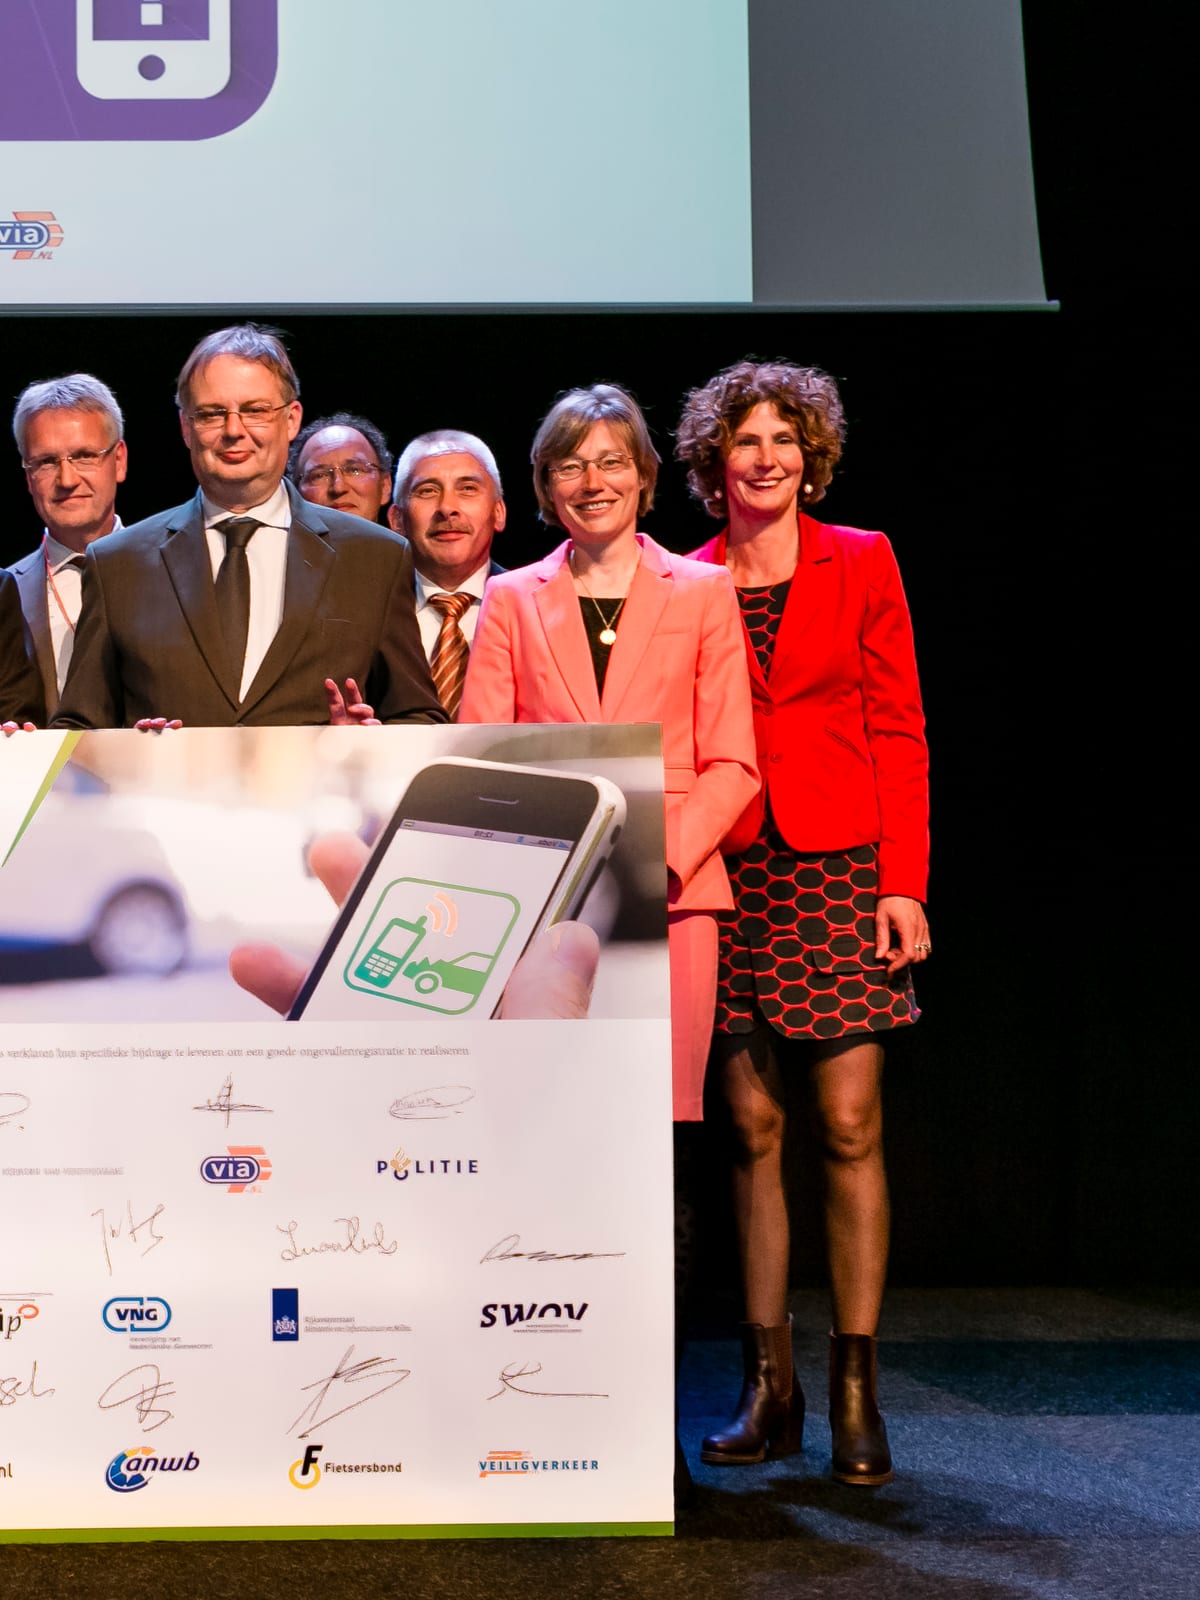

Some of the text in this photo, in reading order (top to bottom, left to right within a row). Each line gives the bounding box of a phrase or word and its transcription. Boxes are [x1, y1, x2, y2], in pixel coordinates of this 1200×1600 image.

[211, 1157, 250, 1178] via
[377, 1159, 479, 1181] POLITIE
[115, 1308, 158, 1321] VNG
[126, 1451, 200, 1473] anwb
[301, 1445, 324, 1476] F
[324, 1461, 402, 1475] Fietsersbond
